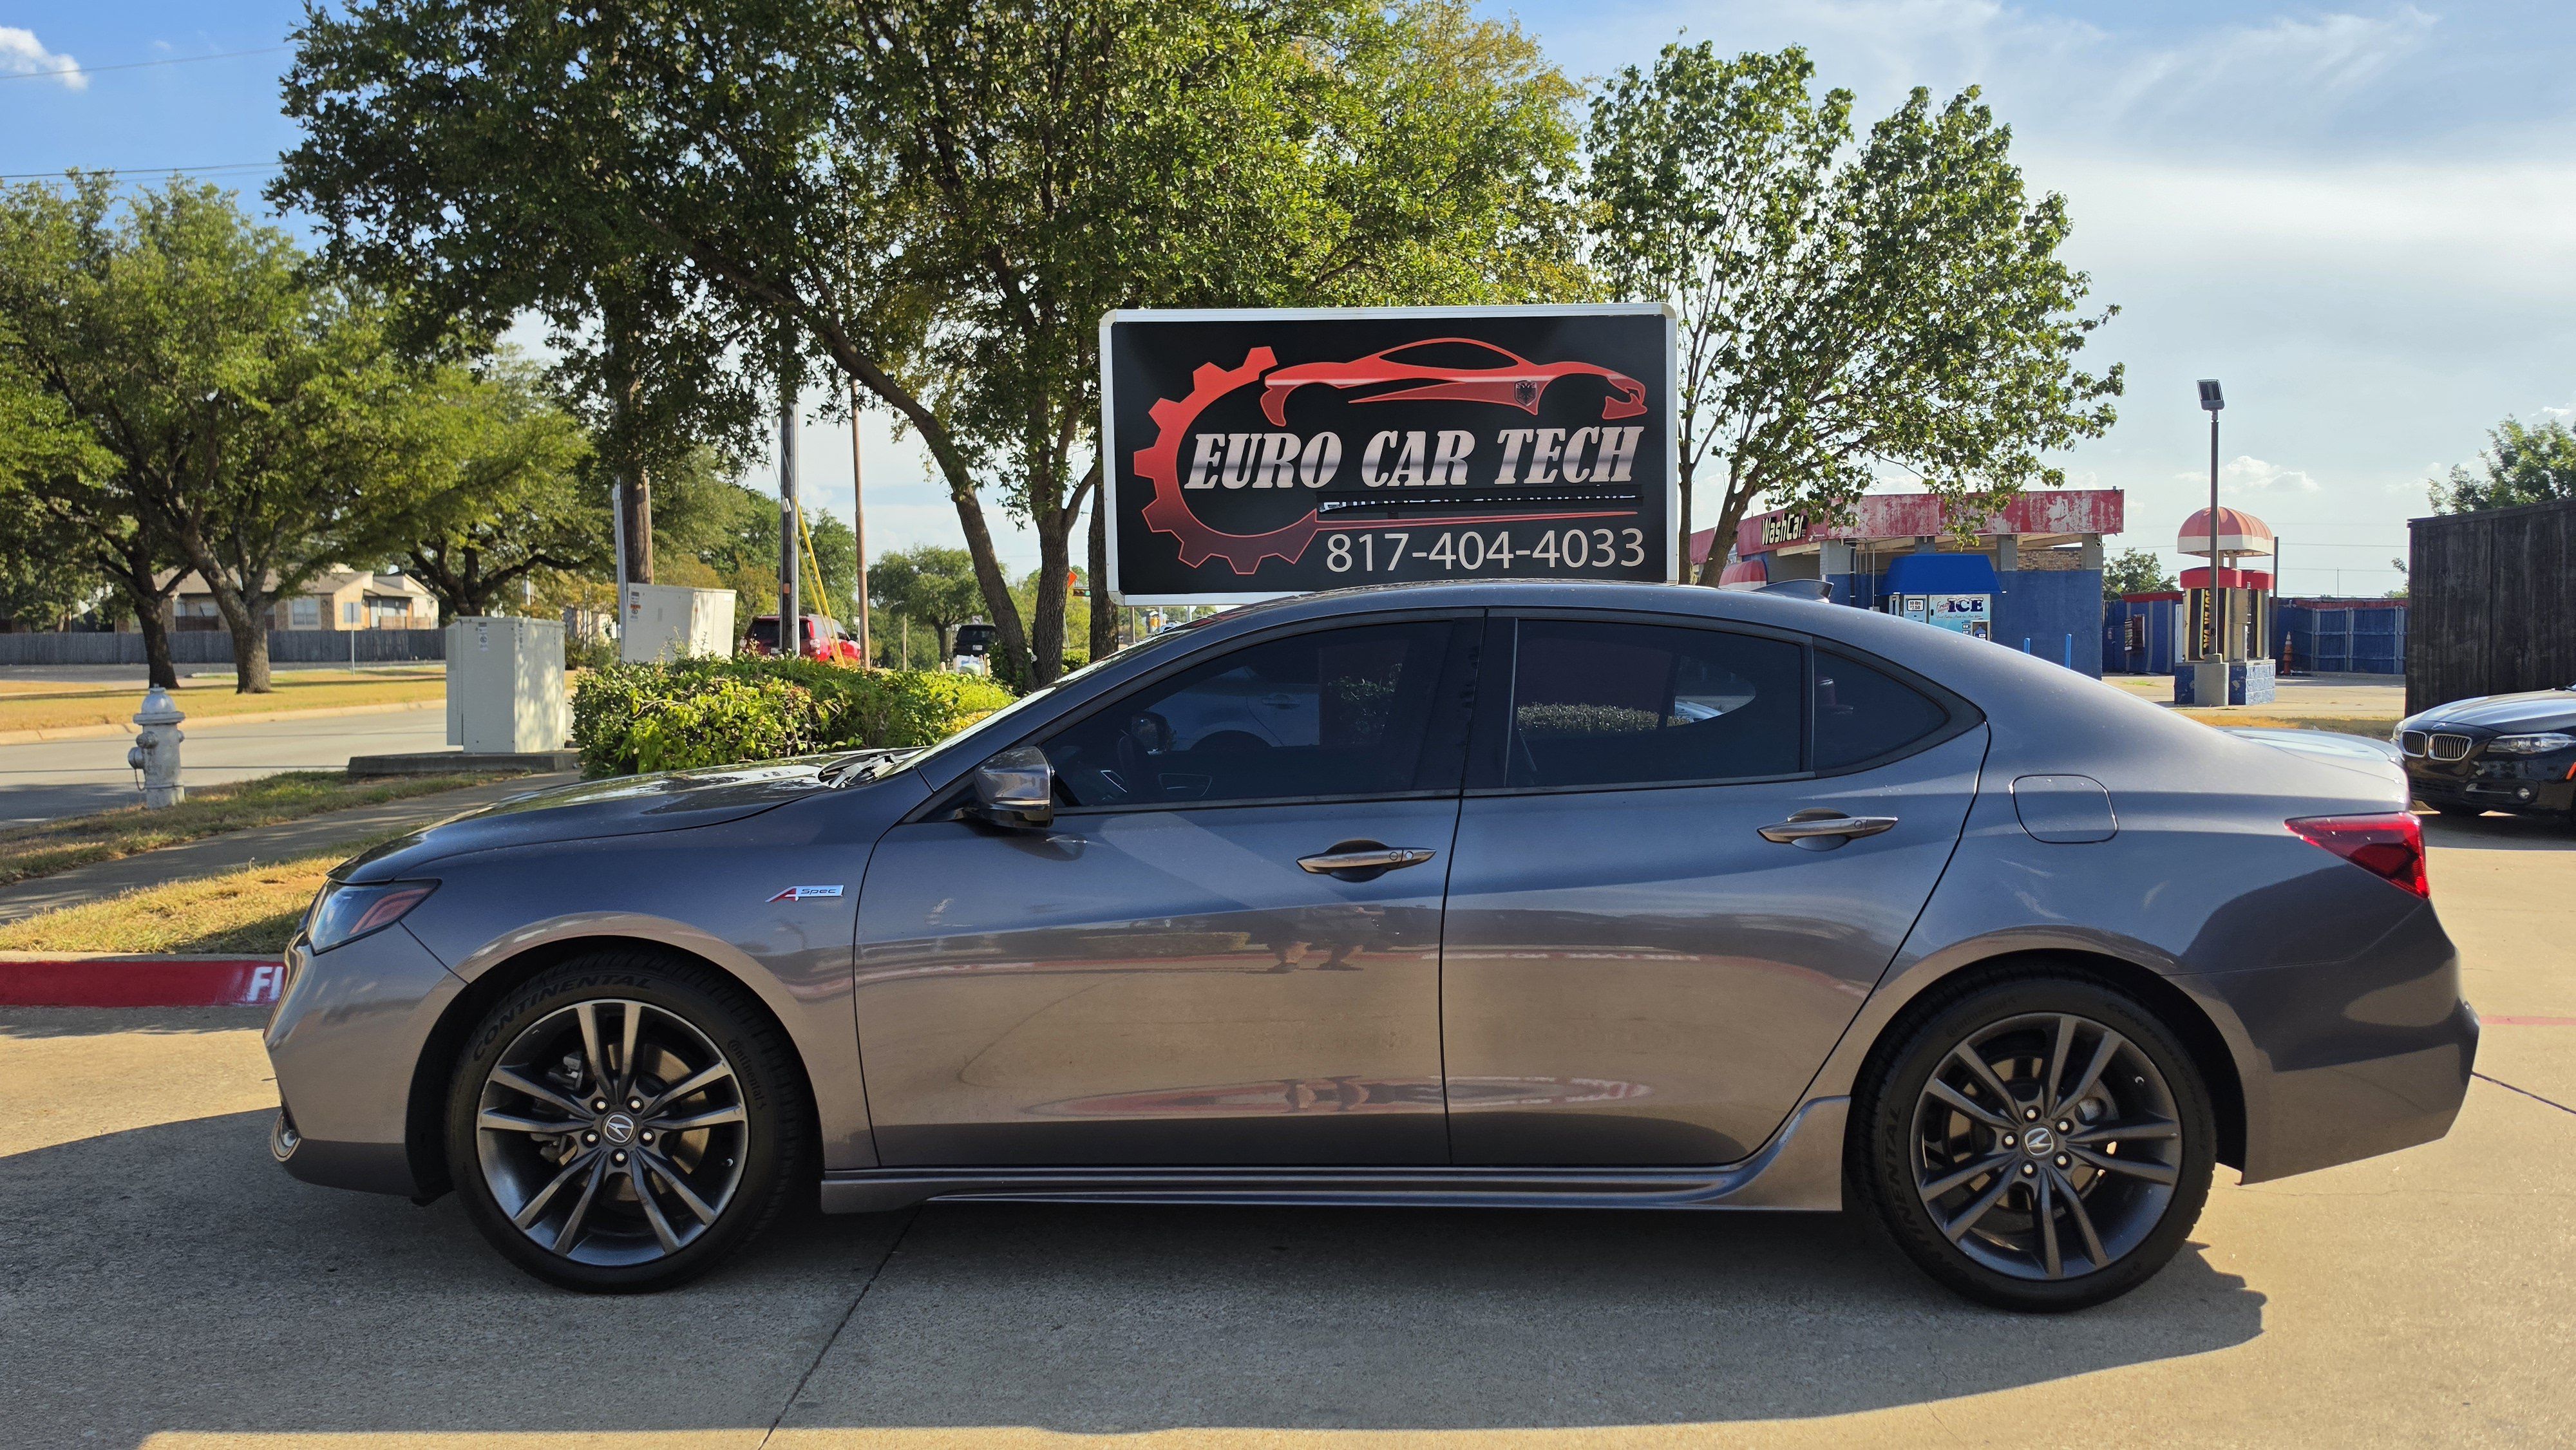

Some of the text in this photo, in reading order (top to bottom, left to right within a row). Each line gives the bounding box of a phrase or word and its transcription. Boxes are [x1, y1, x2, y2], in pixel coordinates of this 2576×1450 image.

[1184, 426, 1644, 489] EURO CAR TECH
[1327, 528, 1645, 572] 817-404-4033
[1947, 598, 1984, 612] ICE
[473, 974, 651, 1060] CONTINENTAL
